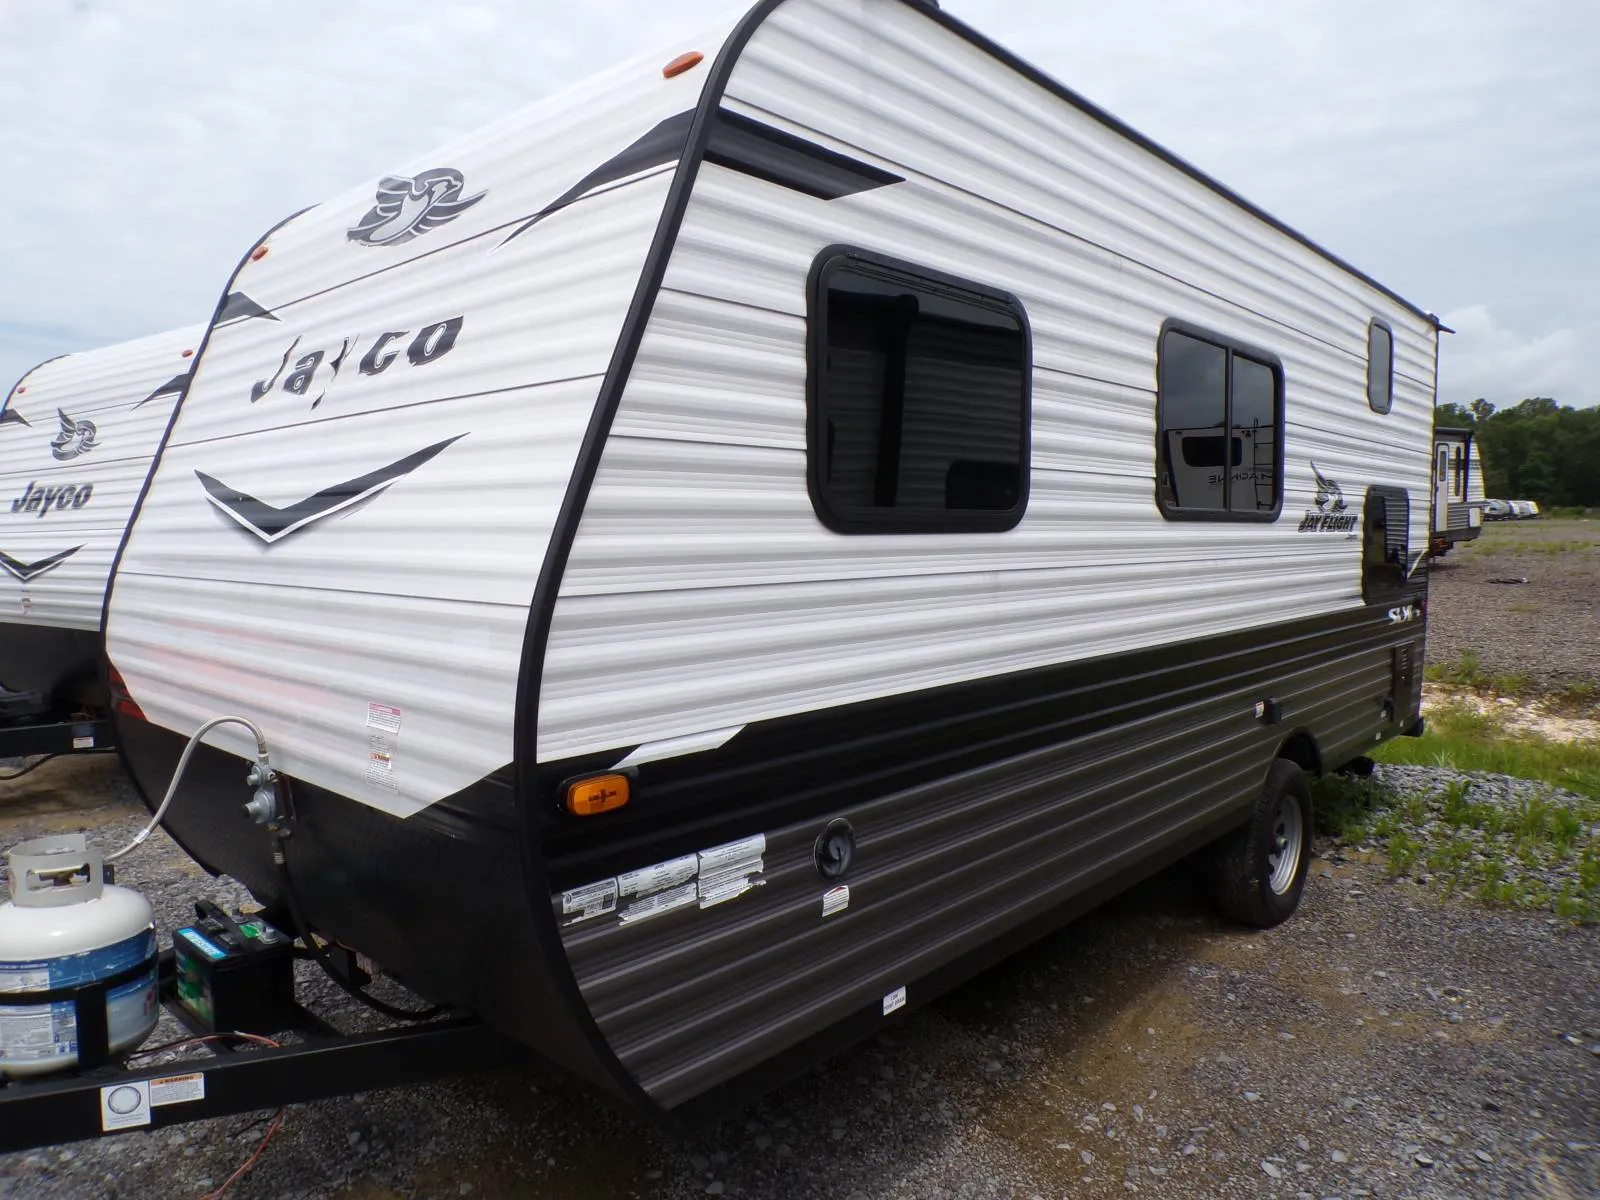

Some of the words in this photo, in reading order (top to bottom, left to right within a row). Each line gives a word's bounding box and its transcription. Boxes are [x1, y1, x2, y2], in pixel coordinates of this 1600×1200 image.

[11, 480, 94, 518] Jayco
[1298, 510, 1322, 533] JAY
[1319, 513, 1358, 533] FLIGHT
